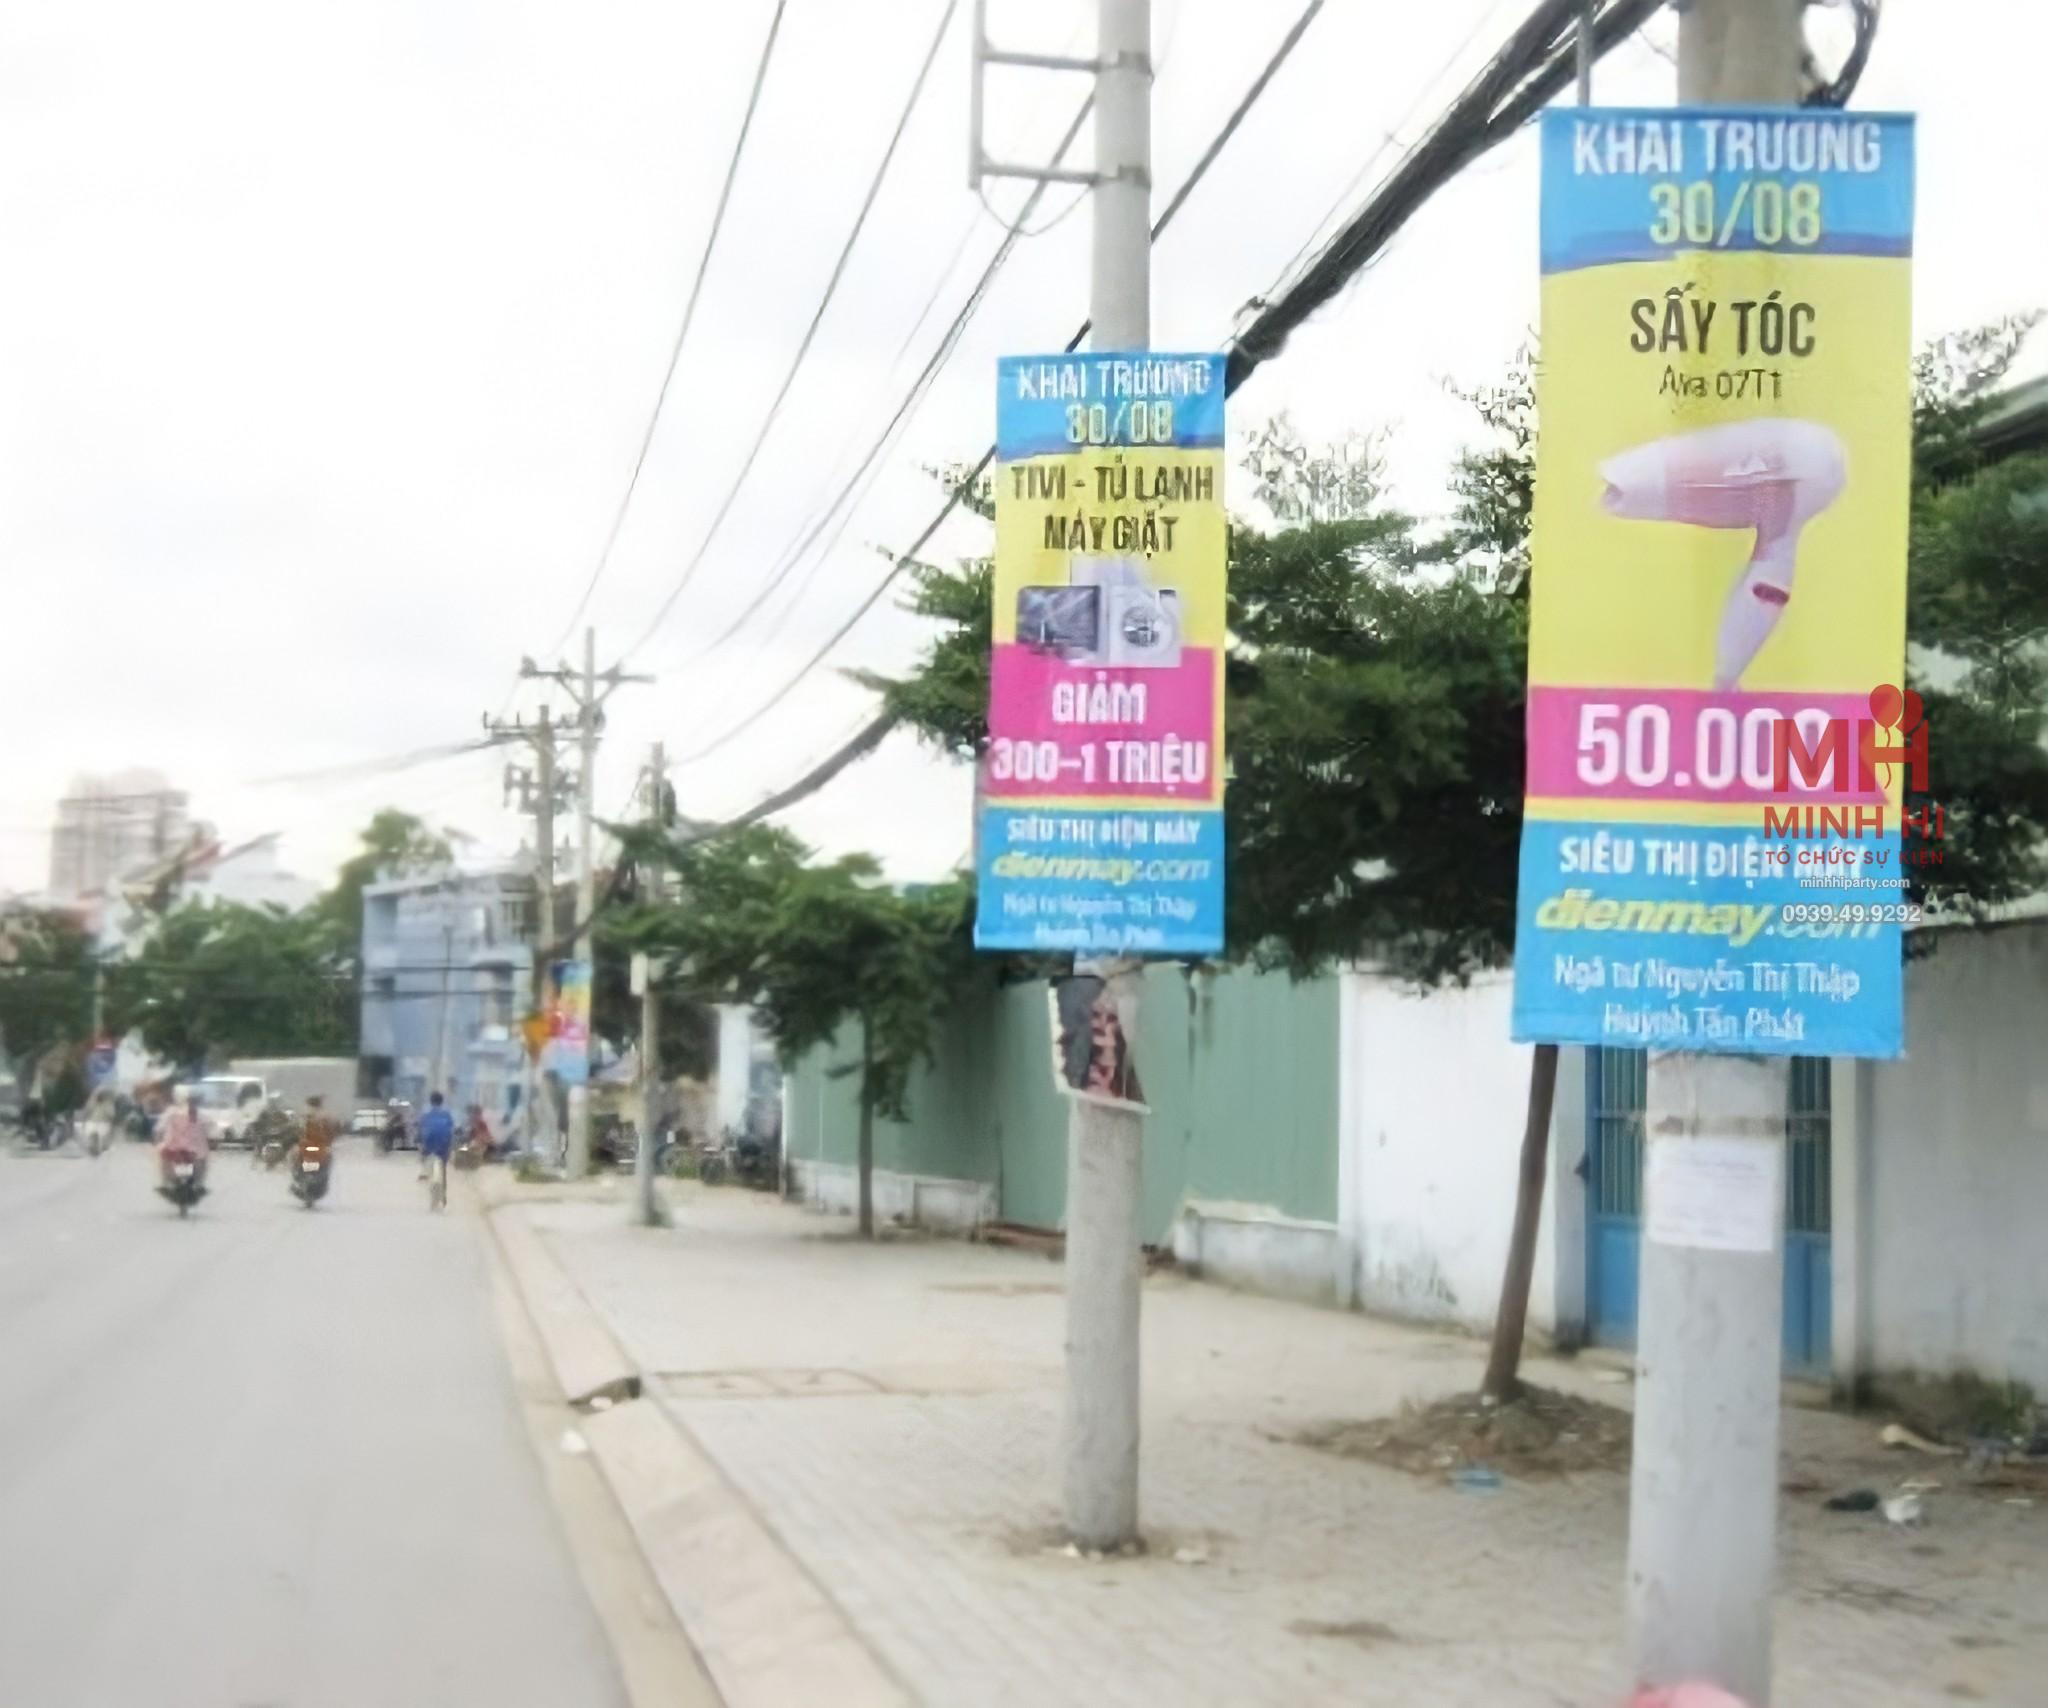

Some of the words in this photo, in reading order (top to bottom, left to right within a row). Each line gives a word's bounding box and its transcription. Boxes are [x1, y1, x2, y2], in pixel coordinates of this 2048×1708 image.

[1574, 120, 1683, 175] KHAI
[1649, 180, 1820, 246] 30/08
[1630, 282, 1717, 354] SẤY
[1730, 290, 1816, 357] TÓC
[1019, 362, 1086, 400] KHAI
[1066, 401, 1172, 444] 30/08
[1134, 465, 1214, 510] LẠNH
[1053, 671, 1147, 724] GIẢM
[1105, 733, 1207, 793] TRIỆU
[1576, 703, 1834, 791] 50.000
[1642, 839, 1698, 886] THỊ
[1706, 835, 1784, 889] ĐIỆN
